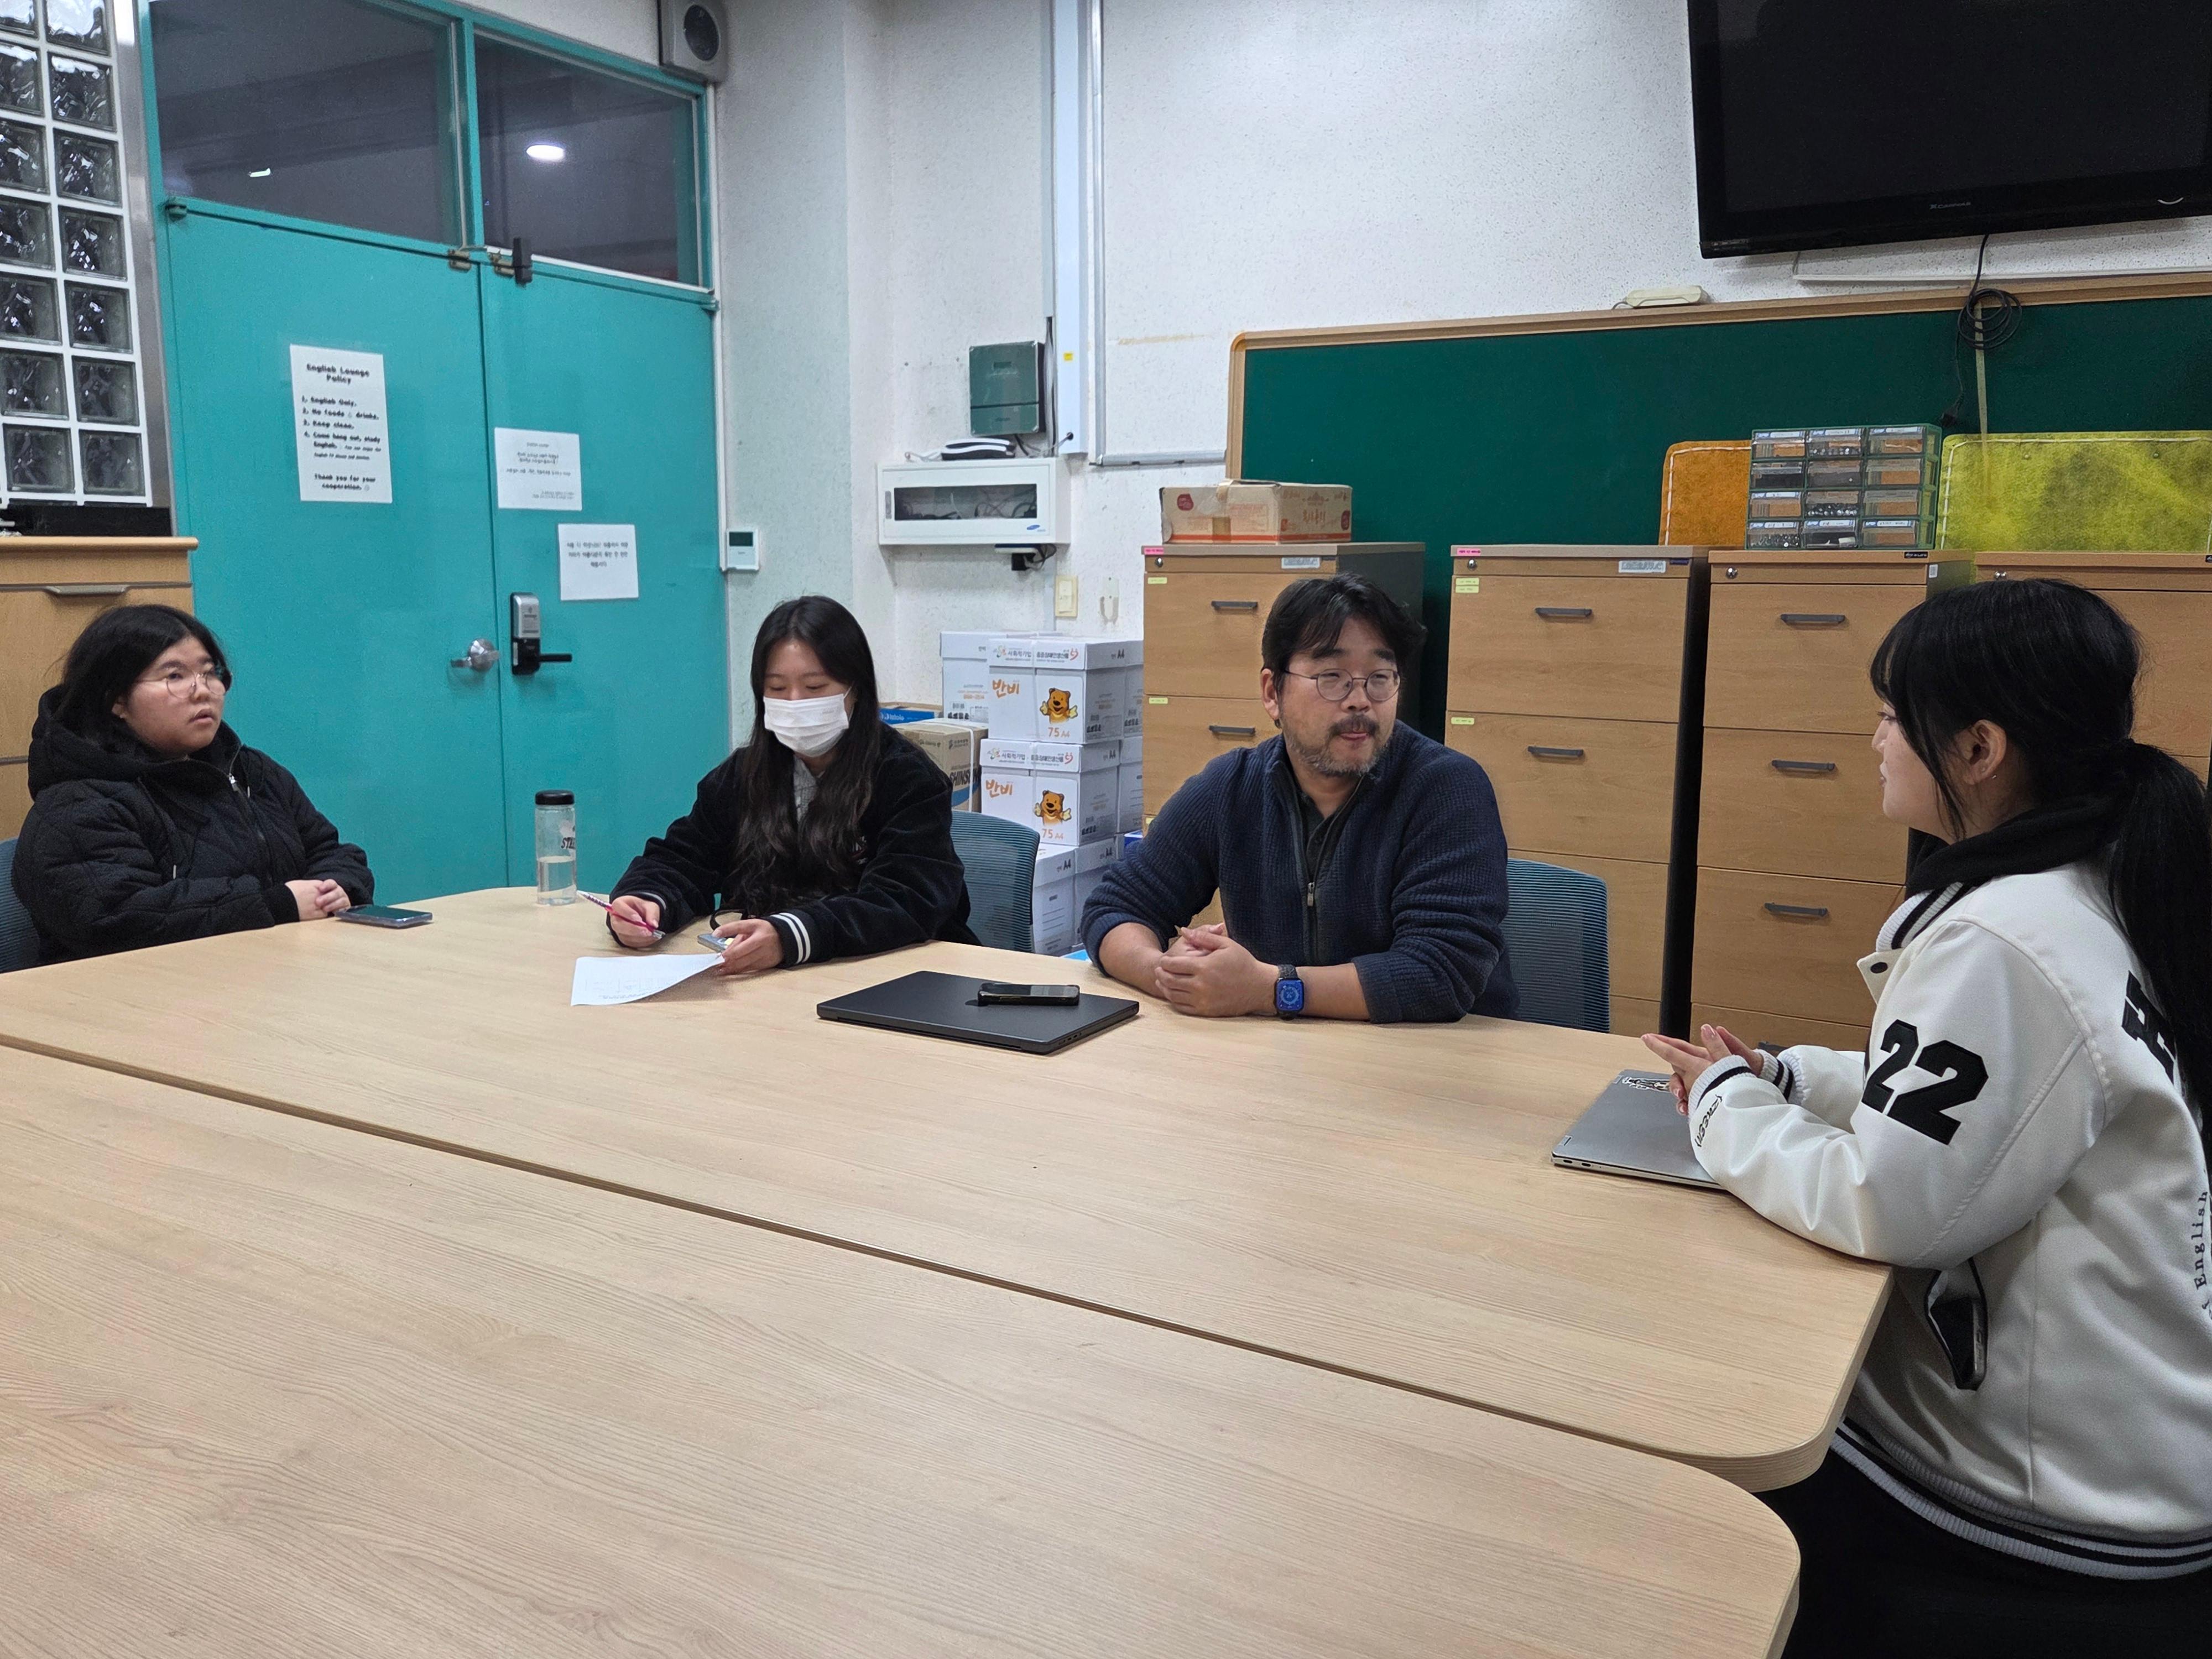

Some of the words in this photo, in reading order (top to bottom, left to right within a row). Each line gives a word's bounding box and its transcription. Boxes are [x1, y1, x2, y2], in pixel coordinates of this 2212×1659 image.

[306, 363, 336, 373] English
[340, 366, 370, 377] Lounge
[326, 374, 351, 385] Policy
[311, 396, 336, 405] English
[325, 408, 345, 417] foods
[333, 432, 347, 441] hang
[1117, 649, 1125, 659] A4
[992, 679, 1020, 698] 반비
[1048, 727, 1060, 738] 75
[1109, 749, 1116, 758] A4
[985, 779, 1013, 798] 반비
[1042, 829, 1053, 839] 75
[1063, 859, 1071, 870] A4
[1861, 1019, 1989, 1145] 22
[2192, 1191, 2208, 1290] English
